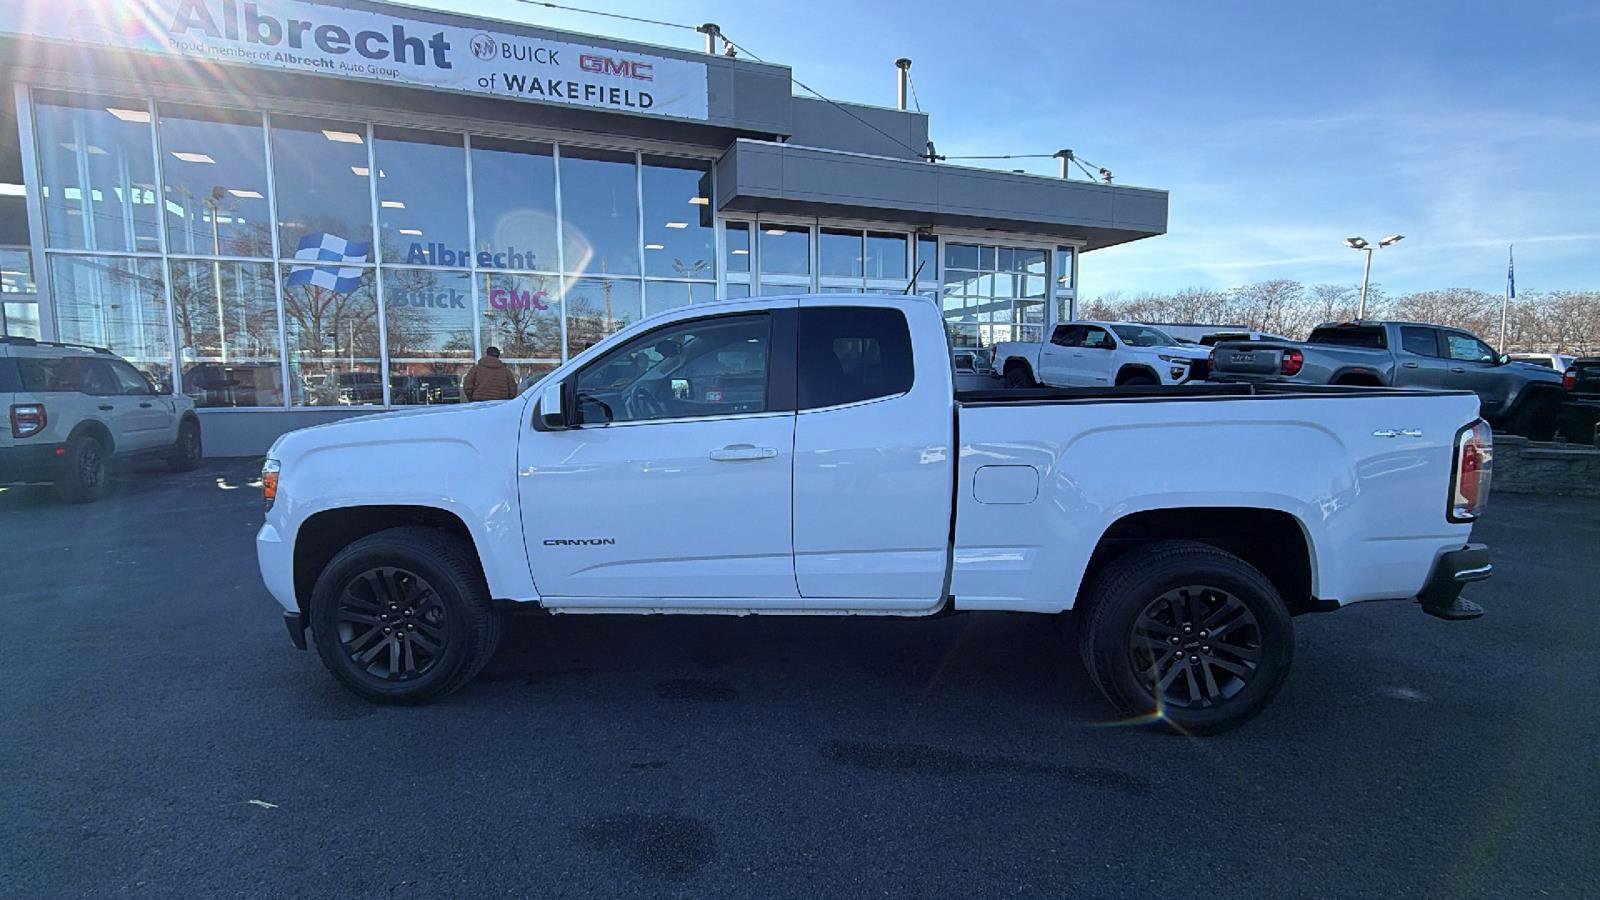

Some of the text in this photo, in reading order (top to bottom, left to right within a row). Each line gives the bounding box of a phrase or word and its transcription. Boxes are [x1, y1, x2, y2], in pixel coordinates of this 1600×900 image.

[169, 0, 453, 70] Albrecht
[168, 38, 401, 78] Proud member of Albrecht Auto Group
[501, 42, 655, 82] BUICK GMC
[477, 73, 654, 109] of WAKEFIELD
[406, 242, 537, 271] Albrecht
[391, 287, 550, 311] Buick GMC
[543, 537, 616, 546] CANYON
